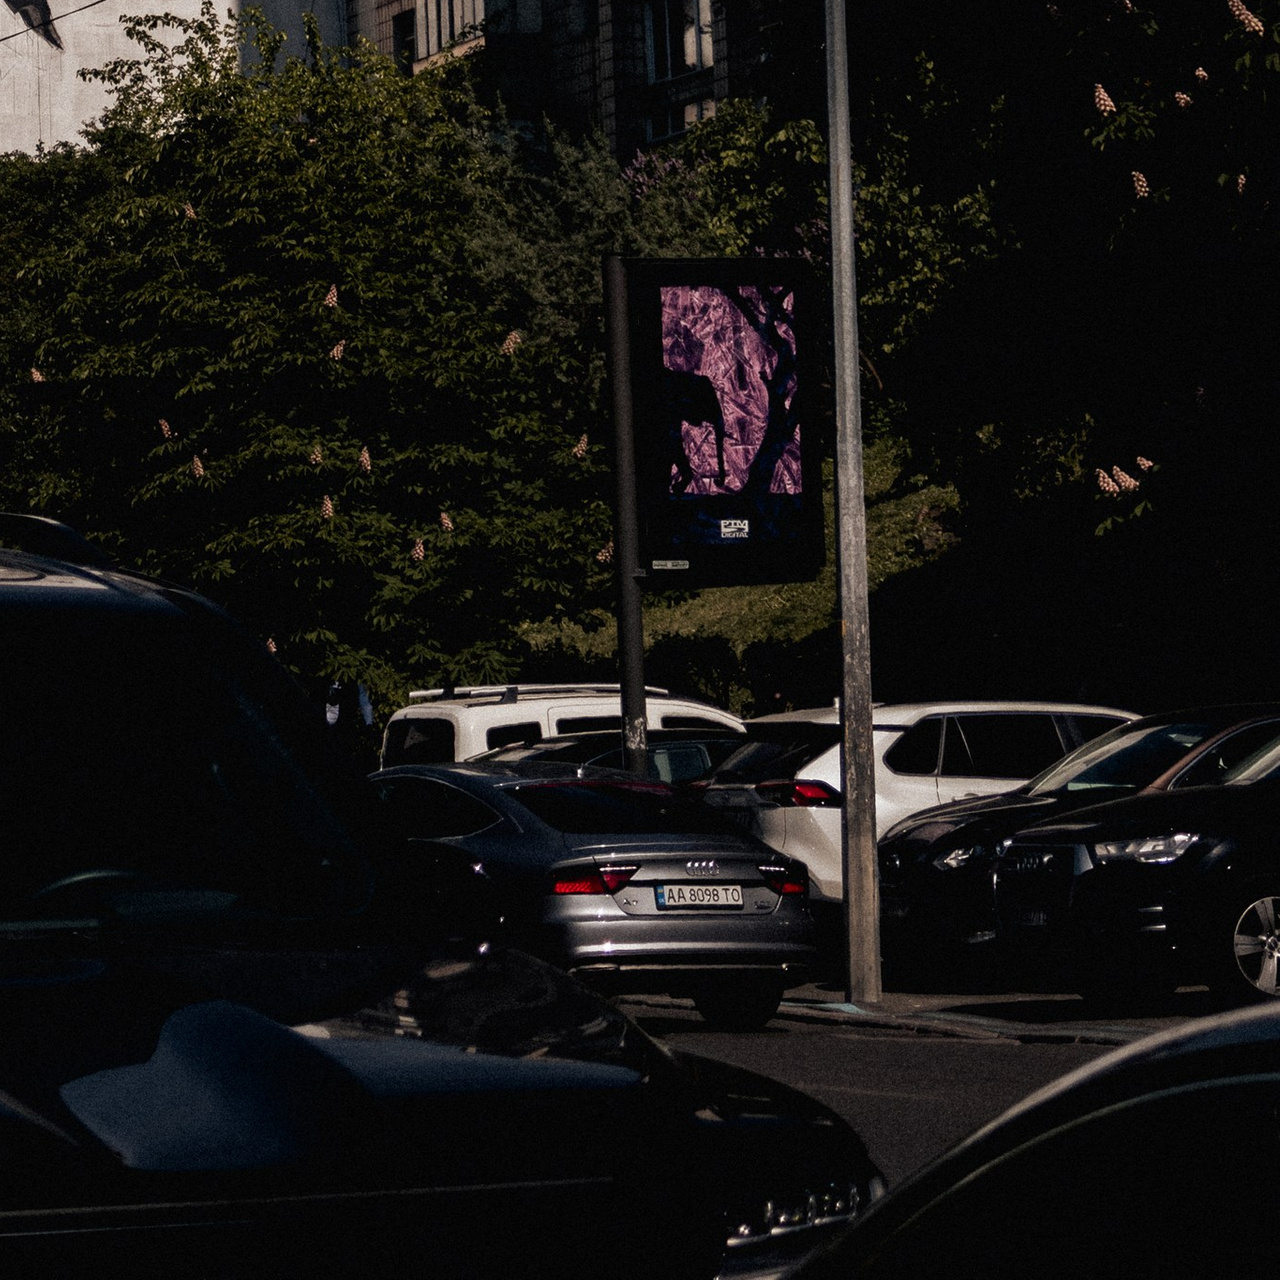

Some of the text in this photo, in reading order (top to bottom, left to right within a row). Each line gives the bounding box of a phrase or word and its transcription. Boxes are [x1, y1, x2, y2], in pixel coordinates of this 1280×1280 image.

[667, 887, 740, 903] AA 8098 TO
